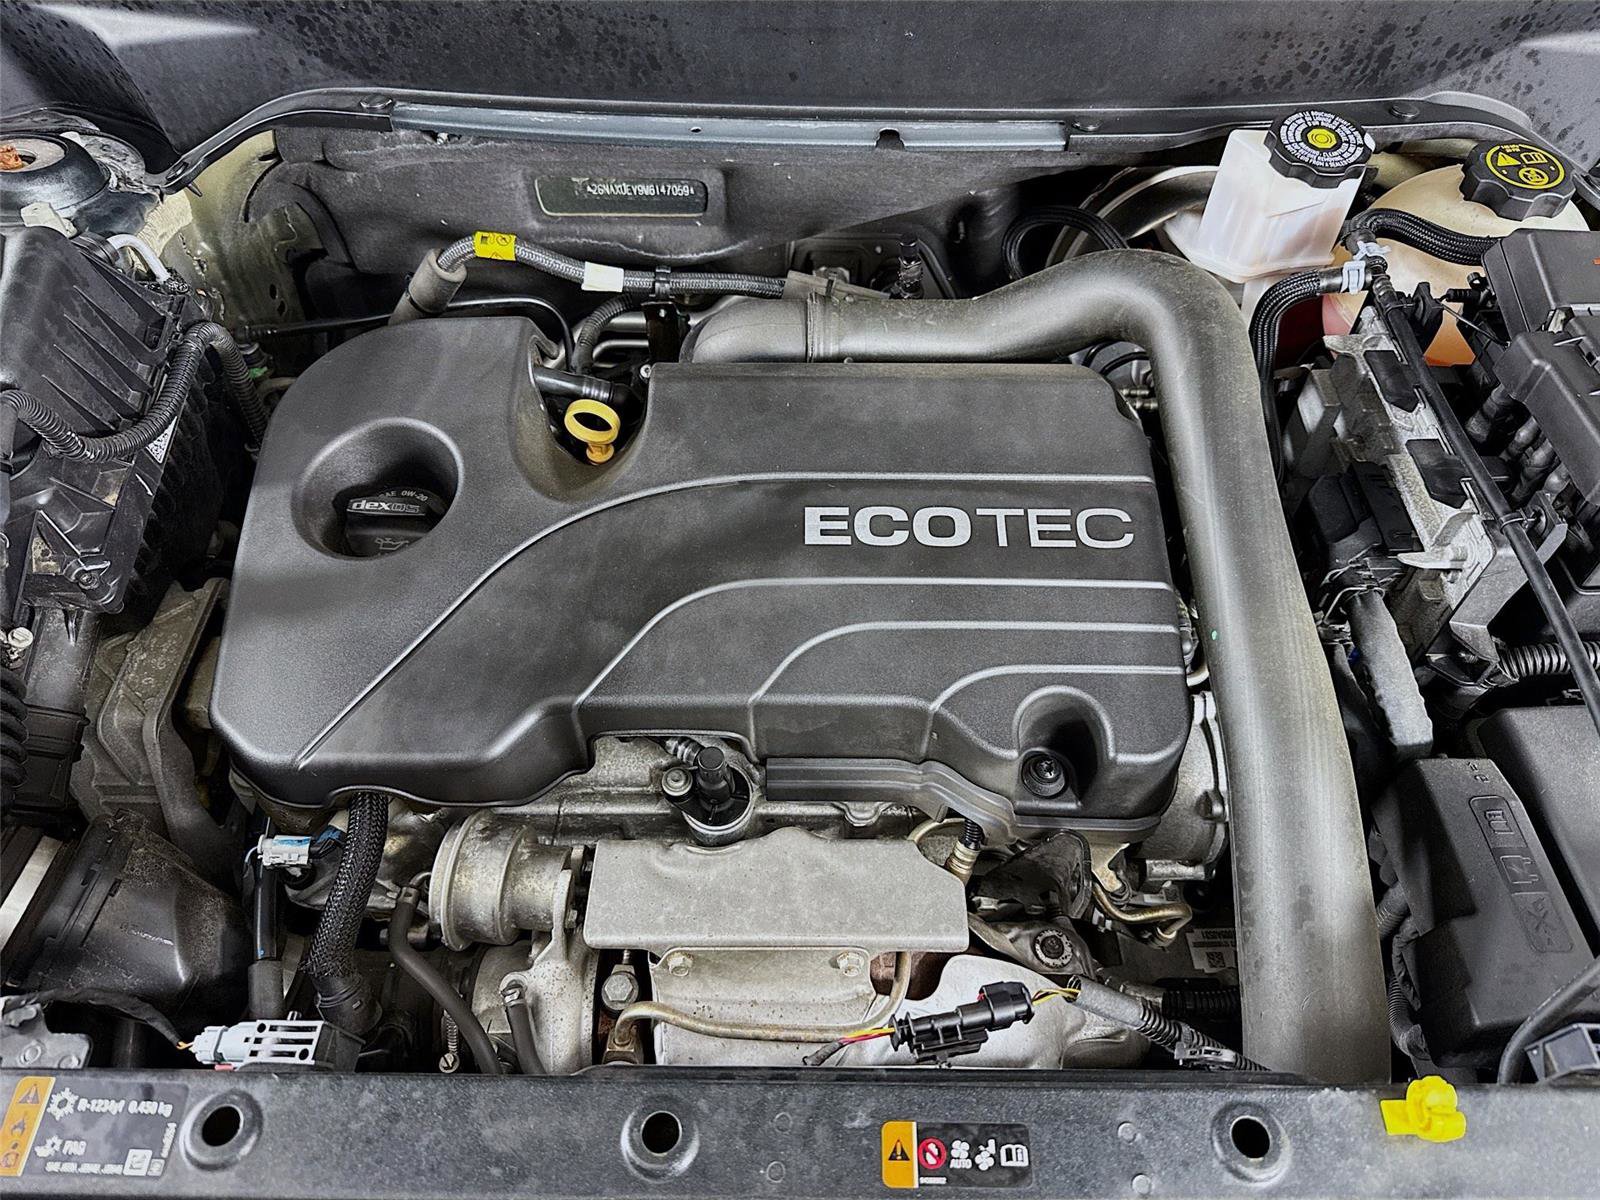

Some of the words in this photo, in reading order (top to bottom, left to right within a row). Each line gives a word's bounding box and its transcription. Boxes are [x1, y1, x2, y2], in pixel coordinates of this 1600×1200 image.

[401, 490, 428, 502] 0W-20
[352, 500, 421, 513] dexos
[804, 506, 1135, 549] ECOTEC
[950, 1158, 973, 1169] AUTO
